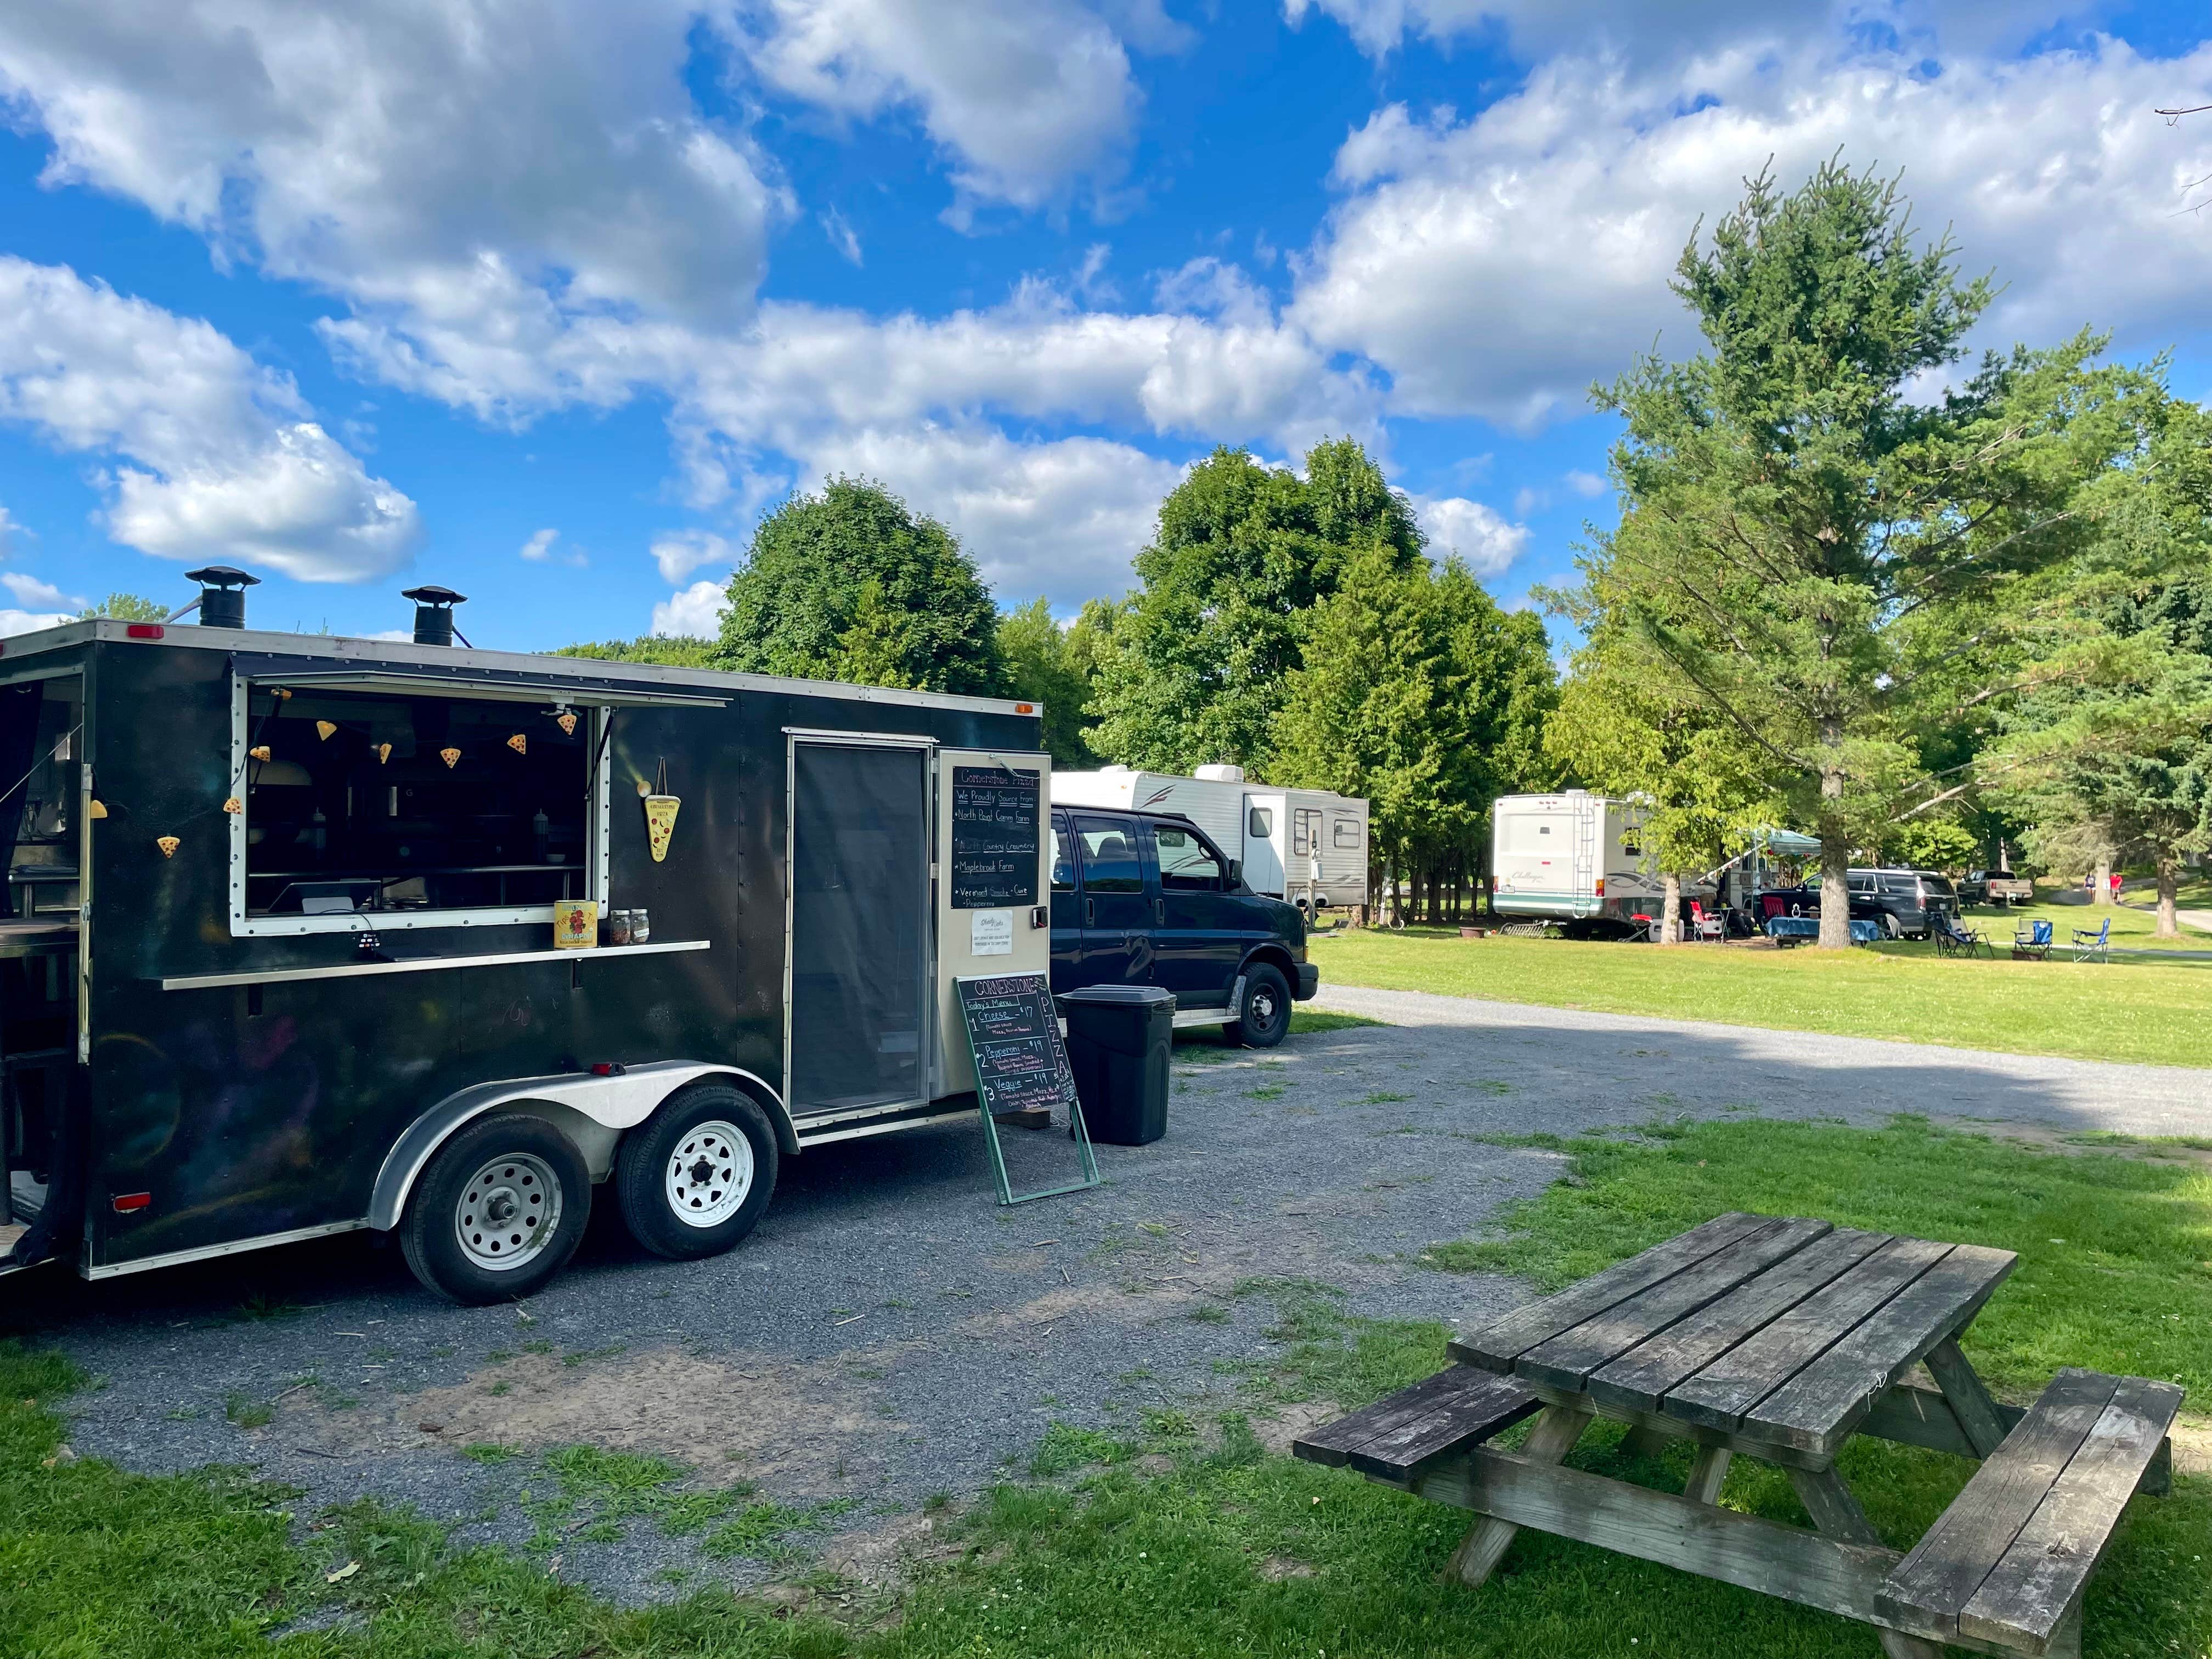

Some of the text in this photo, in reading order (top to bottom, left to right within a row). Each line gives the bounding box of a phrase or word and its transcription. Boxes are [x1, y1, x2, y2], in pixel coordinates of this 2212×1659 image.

[961, 769, 1008, 785] Cornerstone
[957, 789, 969, 800] We
[971, 790, 996, 804] Proudly
[998, 791, 1018, 802] Source
[958, 808, 977, 819] North
[1015, 811, 1030, 822] Farm
[983, 843, 1004, 851] Country
[1006, 841, 1035, 850] Creamery
[960, 859, 1014, 874] Maplebrook Farm
[960, 887, 988, 896] Vermont
[974, 978, 1037, 996] CORNERSTONE
[966, 999, 1011, 1011] Today's Menu
[978, 1011, 1009, 1021] Cheese
[985, 1045, 1020, 1059] Pepperoni
[1029, 1040, 1043, 1052] $19
[993, 1078, 1022, 1092] Veggie
[1034, 1073, 1048, 1084] $19
